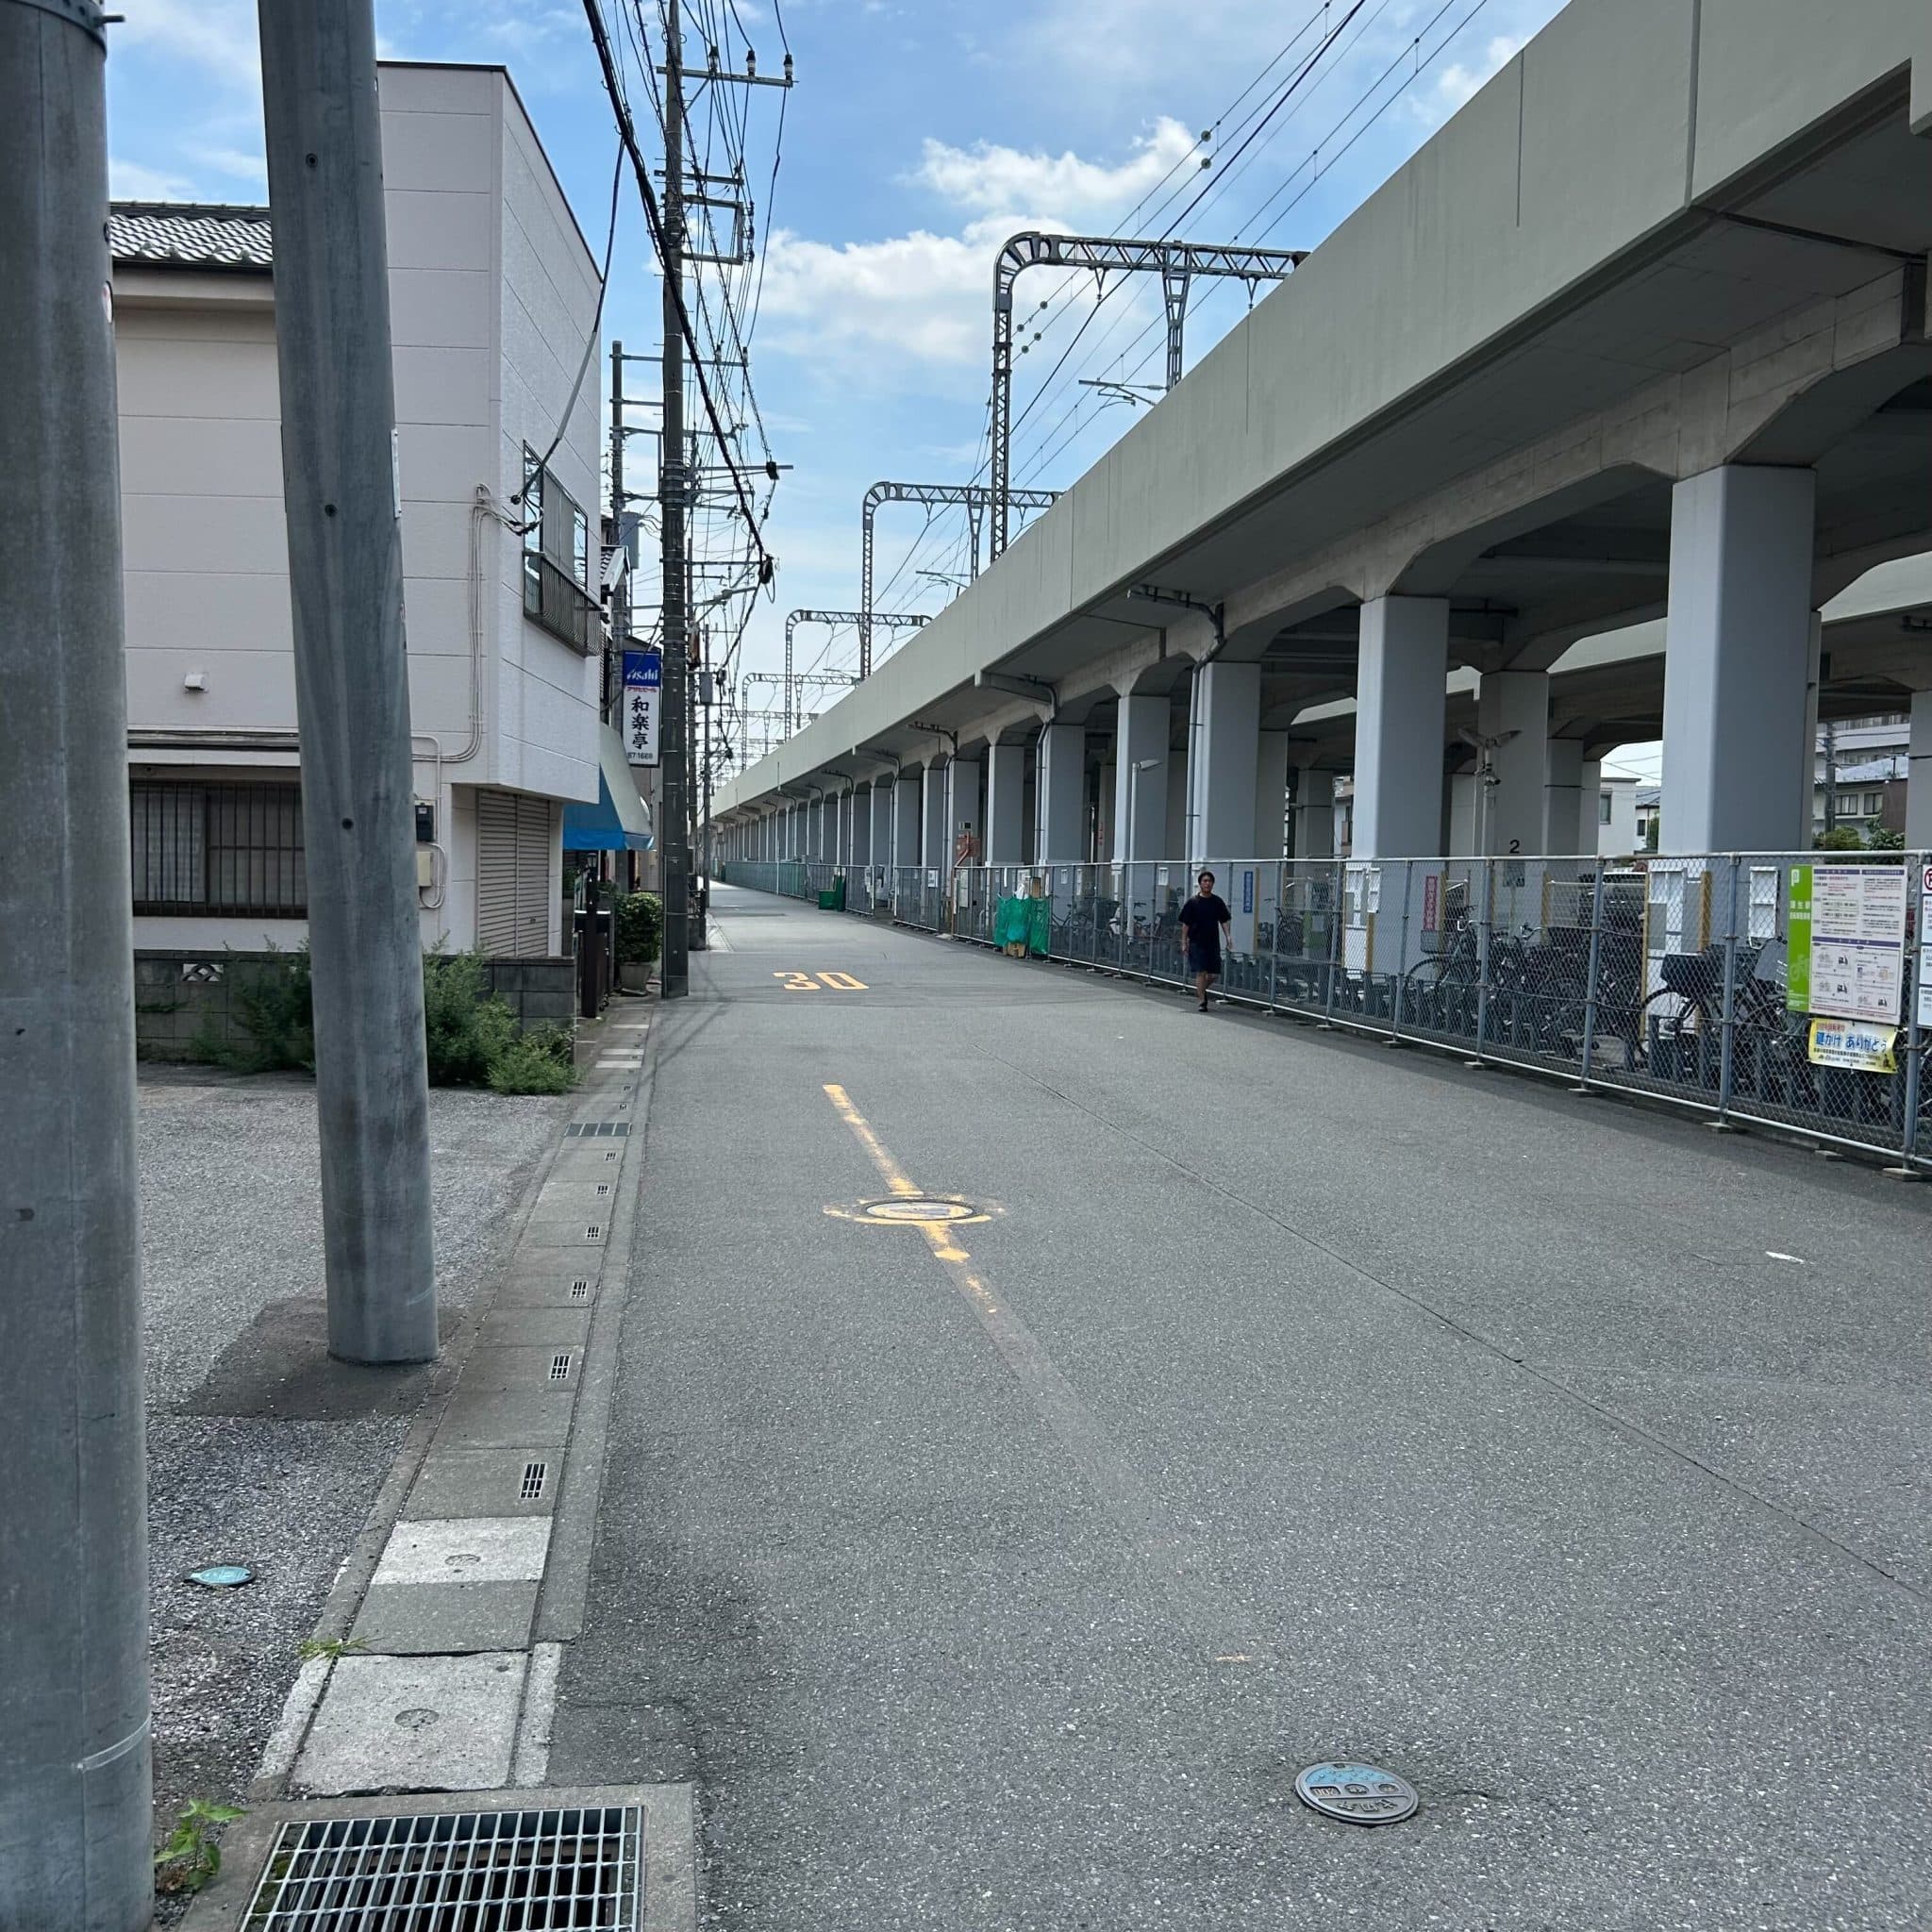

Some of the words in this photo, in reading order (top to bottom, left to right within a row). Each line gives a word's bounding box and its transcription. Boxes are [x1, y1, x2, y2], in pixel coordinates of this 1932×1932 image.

[626, 668, 658, 681] Asahi
[630, 694, 650, 750] 和楽亭
[1509, 839, 1520, 854] 2
[773, 971, 870, 991] 30
[1845, 1034, 1887, 1053] ありがとう
